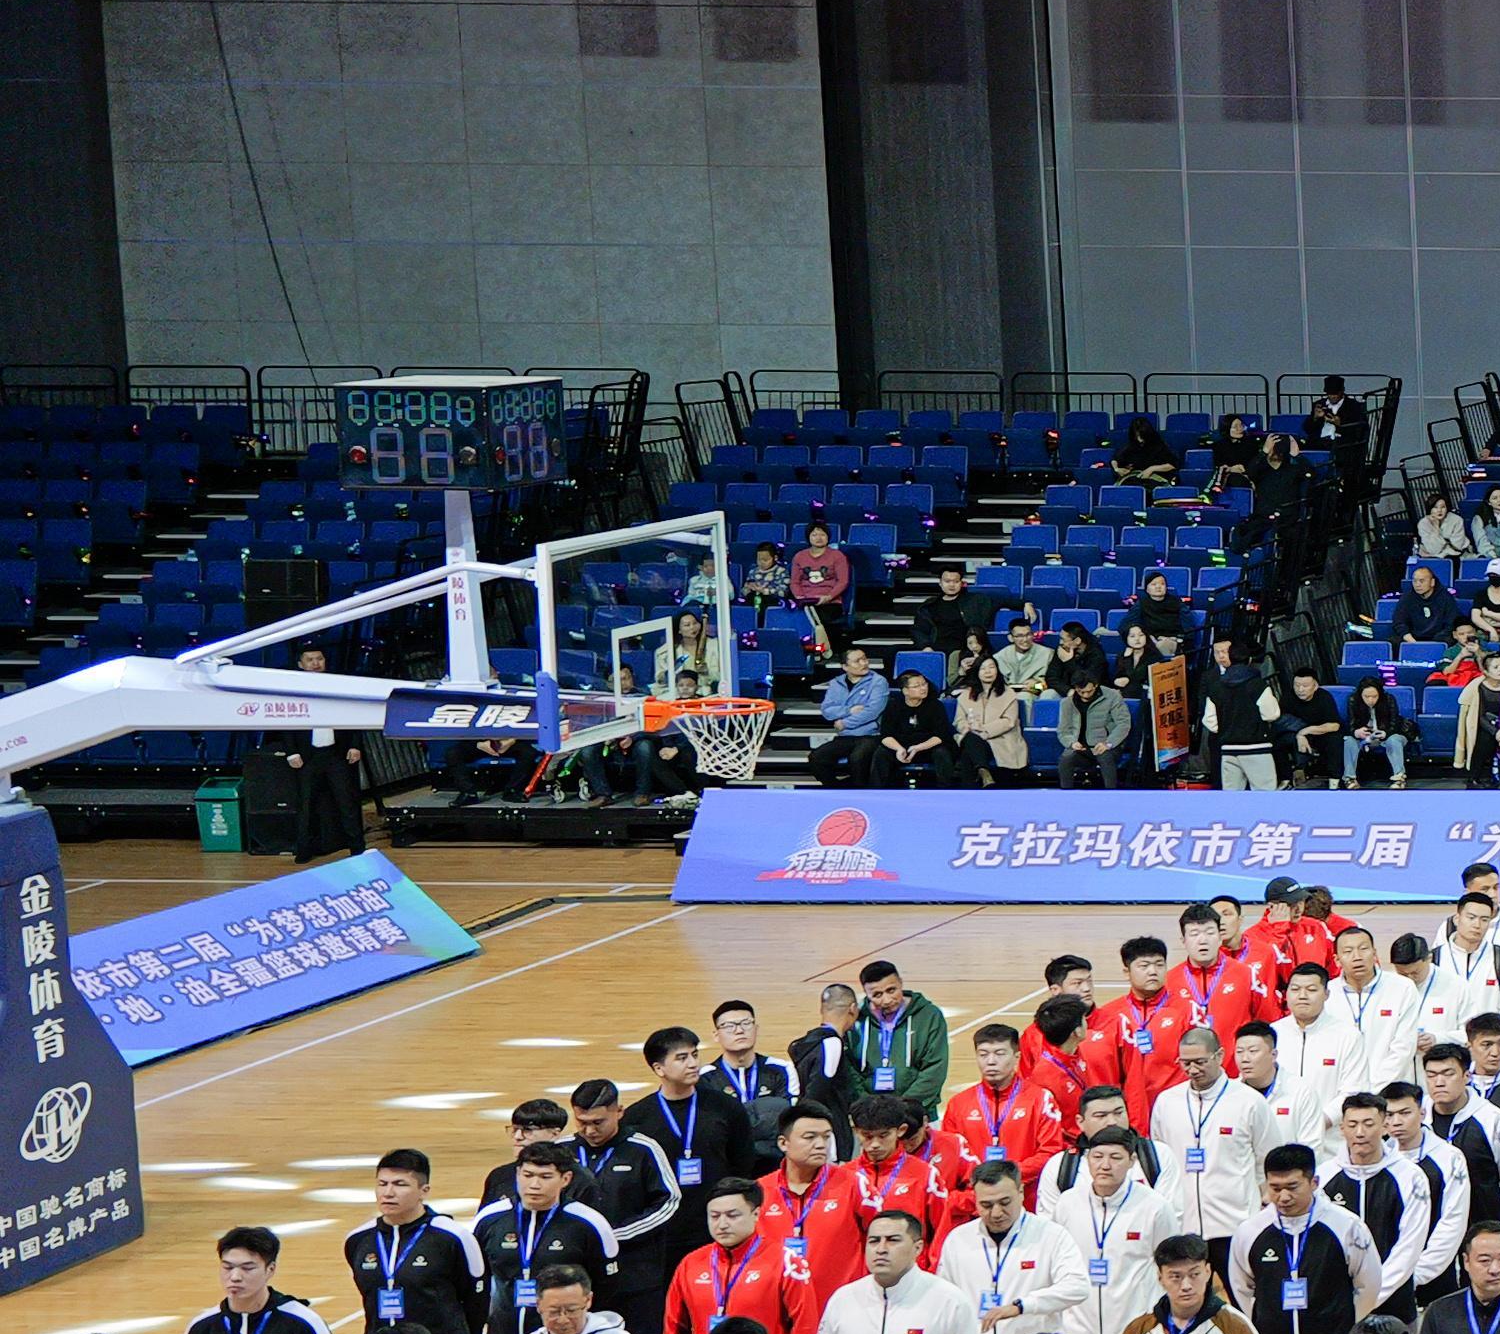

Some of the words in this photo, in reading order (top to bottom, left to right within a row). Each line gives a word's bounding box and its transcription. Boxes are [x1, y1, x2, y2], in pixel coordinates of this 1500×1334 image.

[427, 703, 530, 728] 金陵
[18, 873, 67, 1064] 金陵体育
